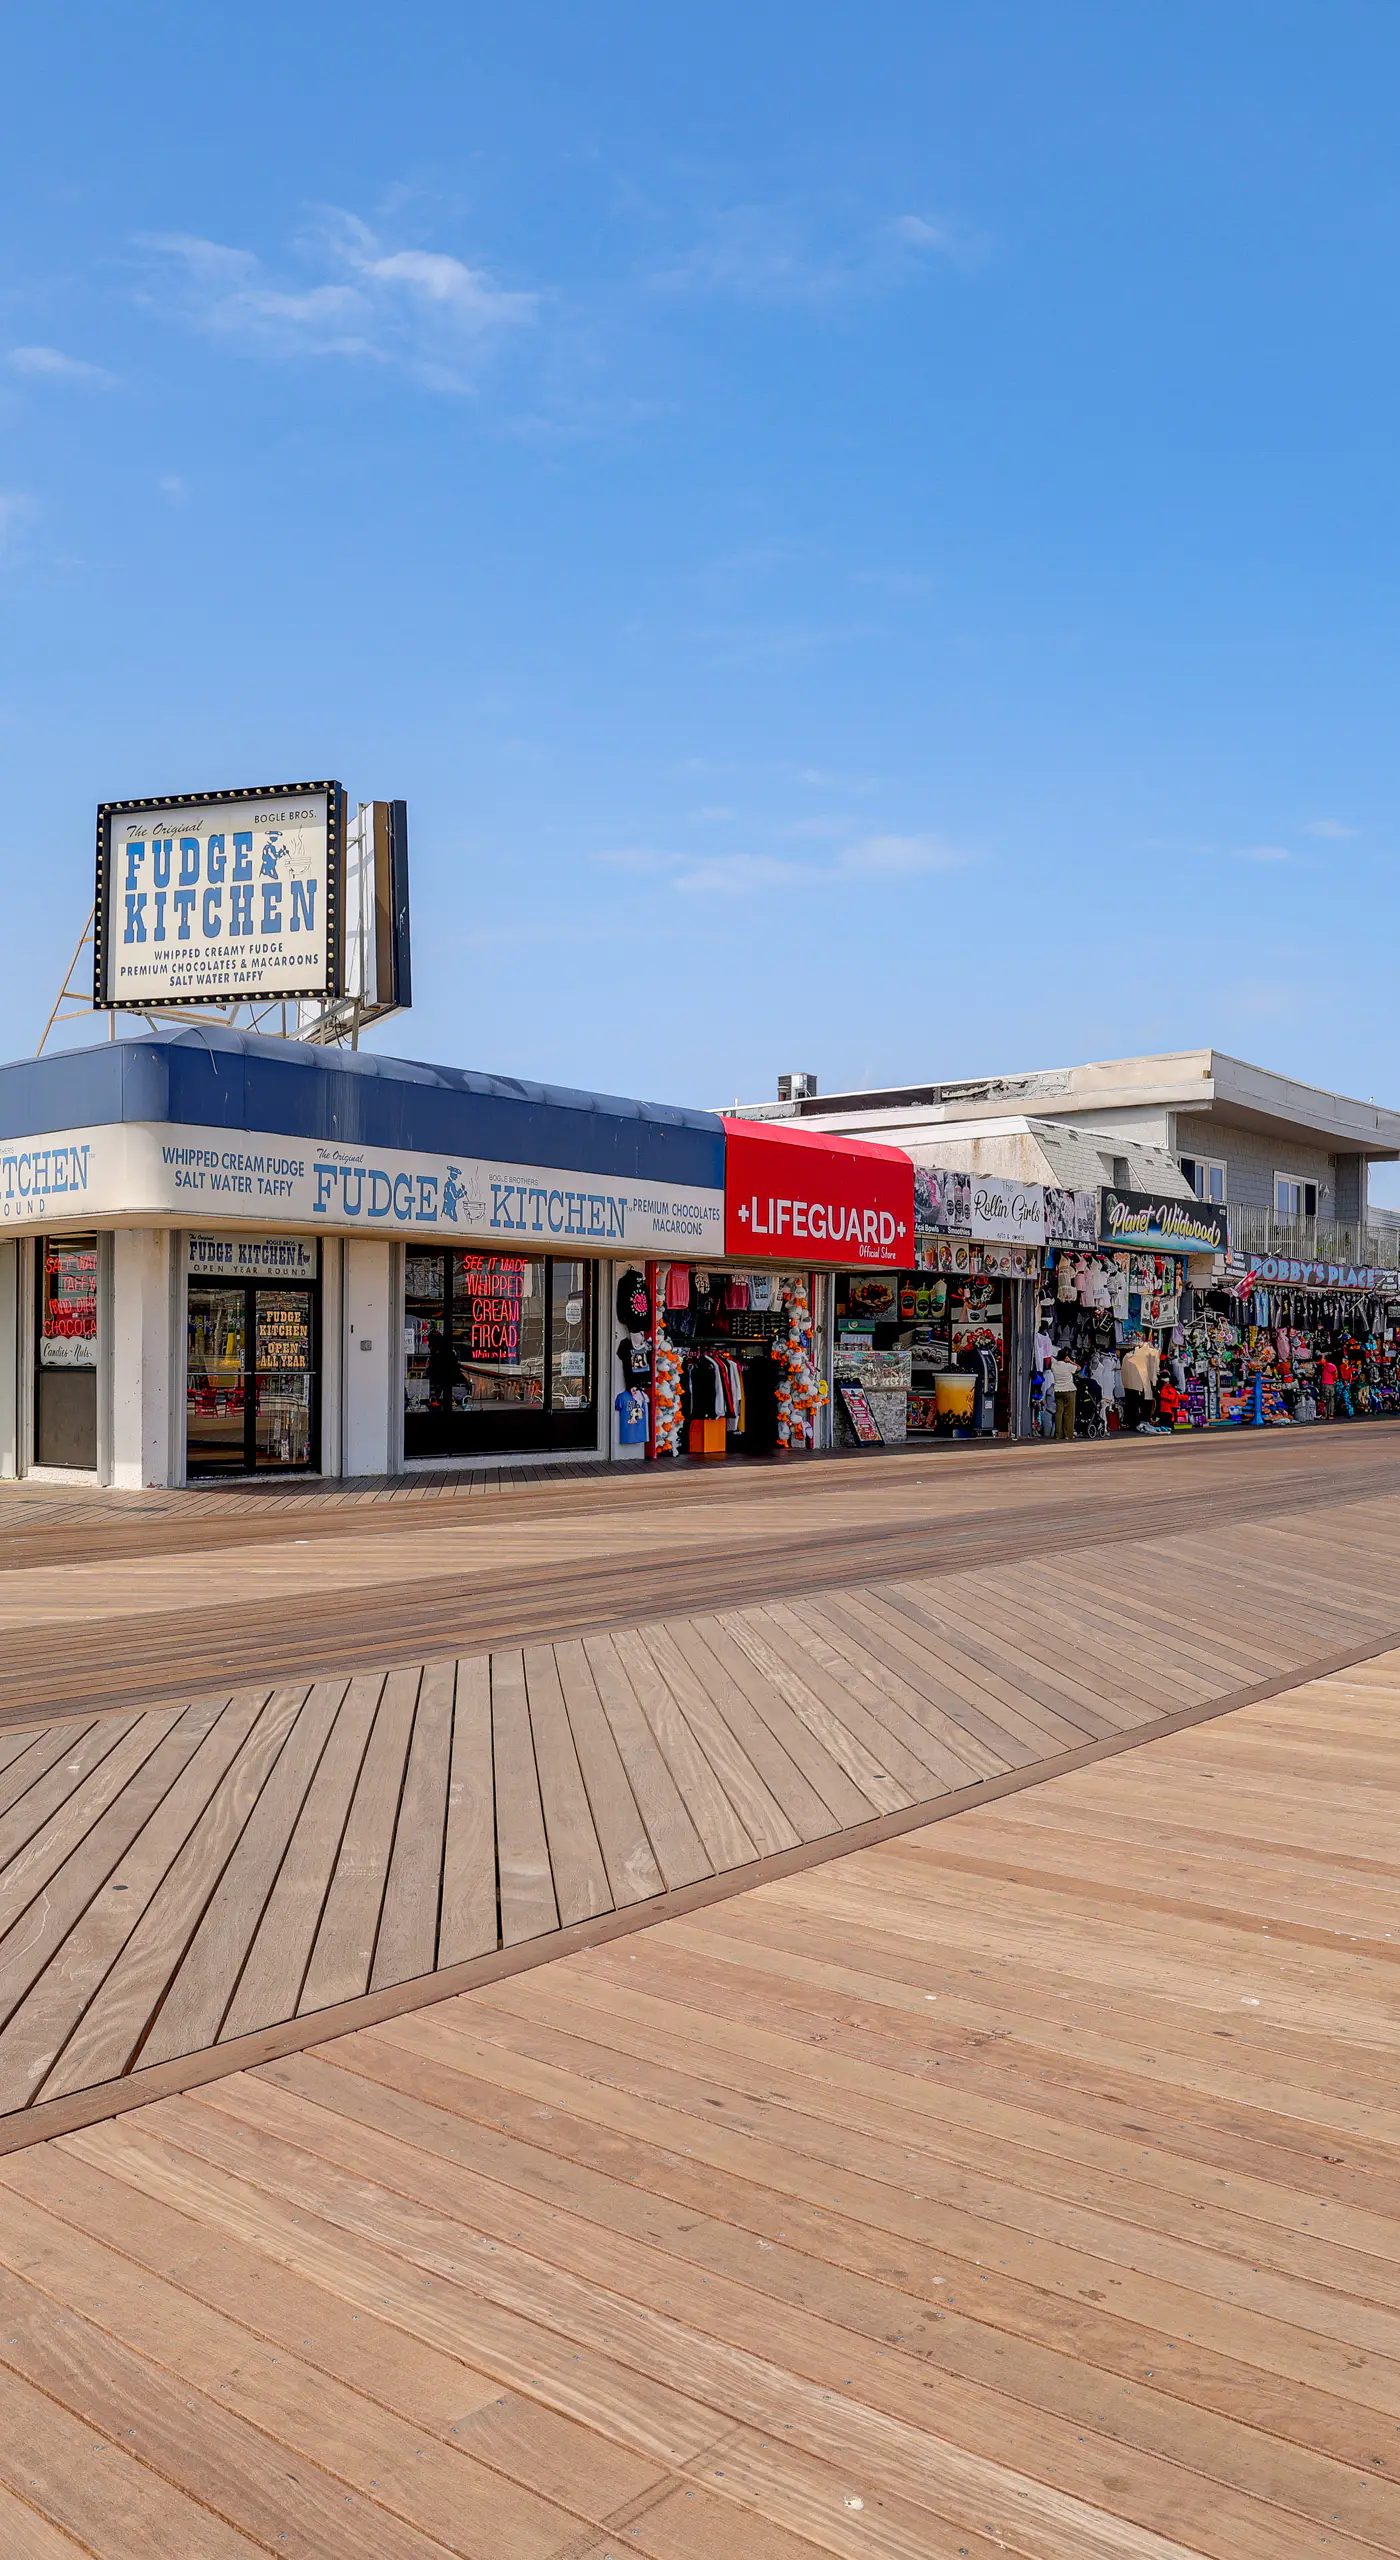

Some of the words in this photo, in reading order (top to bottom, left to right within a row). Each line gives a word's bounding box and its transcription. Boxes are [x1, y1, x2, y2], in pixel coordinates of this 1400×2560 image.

[254, 814, 286, 824] BOGLE
[289, 810, 317, 820] BROS.
[126, 825, 147, 838] The
[152, 820, 204, 838] Original
[125, 831, 253, 891] FUDGE
[124, 879, 318, 944] KITCHEN
[154, 948, 200, 961] WHIPPED
[205, 944, 245, 957] CREAMY
[249, 942, 283, 954] FUDGE
[120, 964, 168, 977] PREMIUM
[172, 959, 237, 973] CHOCOLATES
[240, 959, 247, 969] &
[251, 953, 319, 968] MACAROONS
[169, 974, 193, 987] SALT
[196, 973, 230, 985] WATER
[234, 970, 264, 983] TAFFY
[162, 1146, 219, 1168] WHIPPED
[221, 1152, 265, 1173] CREAM
[266, 1157, 304, 1178] FUDGE
[317, 1148, 330, 1159] The
[332, 1150, 364, 1164] Original
[0, 1145, 90, 1199] TCHEN
[489, 1173, 508, 1183] BOGLE
[509, 1176, 539, 1186] BROTHERS
[175, 1170, 205, 1189] SALT
[210, 1174, 252, 1193] WATER
[257, 1177, 293, 1197] TAFFY
[312, 1163, 438, 1221] FUDGE
[1002, 1180, 1014, 1193] The
[489, 1184, 627, 1239] KITCHEN
[633, 1198, 669, 1215] PREMIUM
[672, 1203, 720, 1221] CHOCOLATES
[1011, 1193, 1040, 1229] Girls
[652, 1218, 703, 1236] MACAROONS
[751, 1196, 896, 1245] LIFEGUARD
[925, 1223, 939, 1233] Bowls
[948, 1226, 971, 1236] Smoothies
[1109, 1202, 1156, 1238] Planet
[1156, 1202, 1221, 1248] Wildwood
[190, 1241, 232, 1263] FUDGE
[239, 1243, 296, 1266] KITCHEN
[859, 1244, 880, 1258] Official
[881, 1246, 896, 1260] Store
[46, 1256, 71, 1273] SALT
[193, 1264, 224, 1273] OPEN
[233, 1267, 258, 1275] YEAR
[268, 1267, 306, 1276] ROUND
[463, 1255, 485, 1270] SEE
[487, 1257, 498, 1270] IT
[500, 1258, 528, 1273] MADE
[1250, 1255, 1325, 1286] BOBBY'S
[1328, 1265, 1375, 1289] PLACE
[465, 1273, 525, 1298] WHIPPED
[266, 1311, 301, 1323] FUDGE
[472, 1298, 520, 1322] CREAM
[259, 1325, 308, 1336] KITCHEN
[267, 1343, 299, 1354] OPEN
[260, 1355, 279, 1367] ALL
[281, 1355, 306, 1367] YEAR
